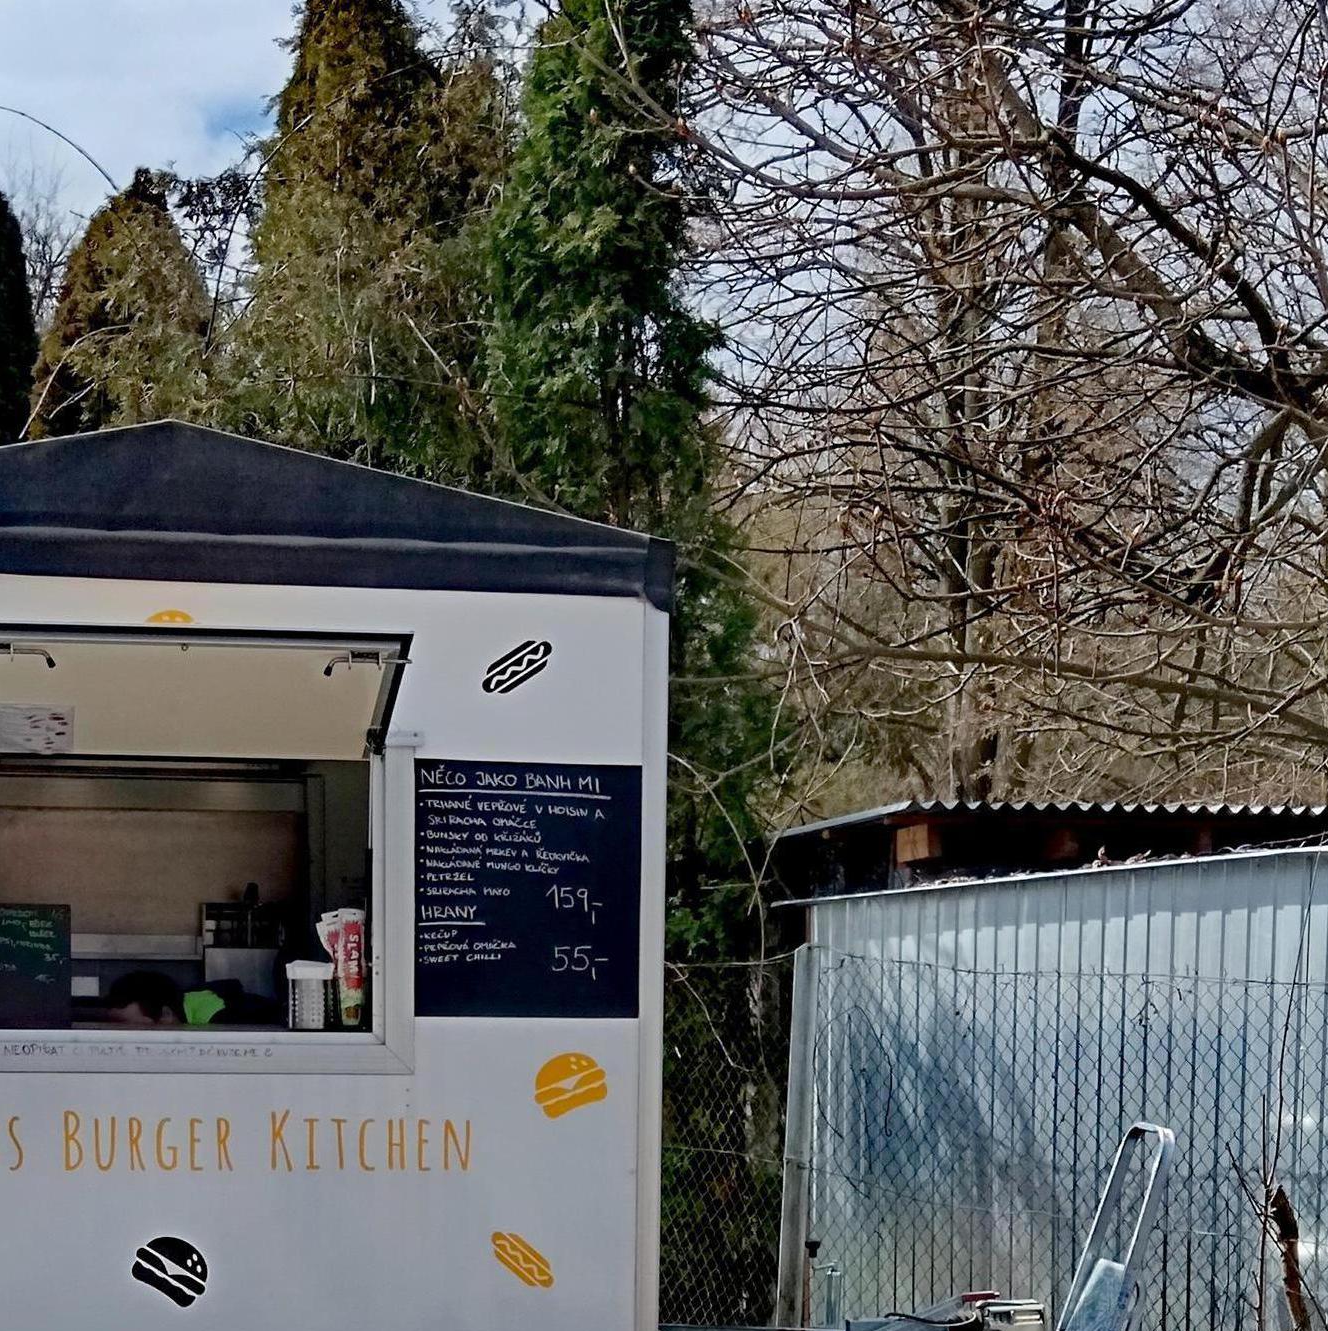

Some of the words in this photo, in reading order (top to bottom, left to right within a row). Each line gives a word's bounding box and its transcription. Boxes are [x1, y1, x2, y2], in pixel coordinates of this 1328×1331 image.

[421, 765, 466, 785] NĚCO
[476, 772, 517, 786] JAKO
[525, 773, 570, 790] BANH
[579, 776, 599, 793] MI
[536, 805, 542, 814] V
[595, 809, 605, 820] A
